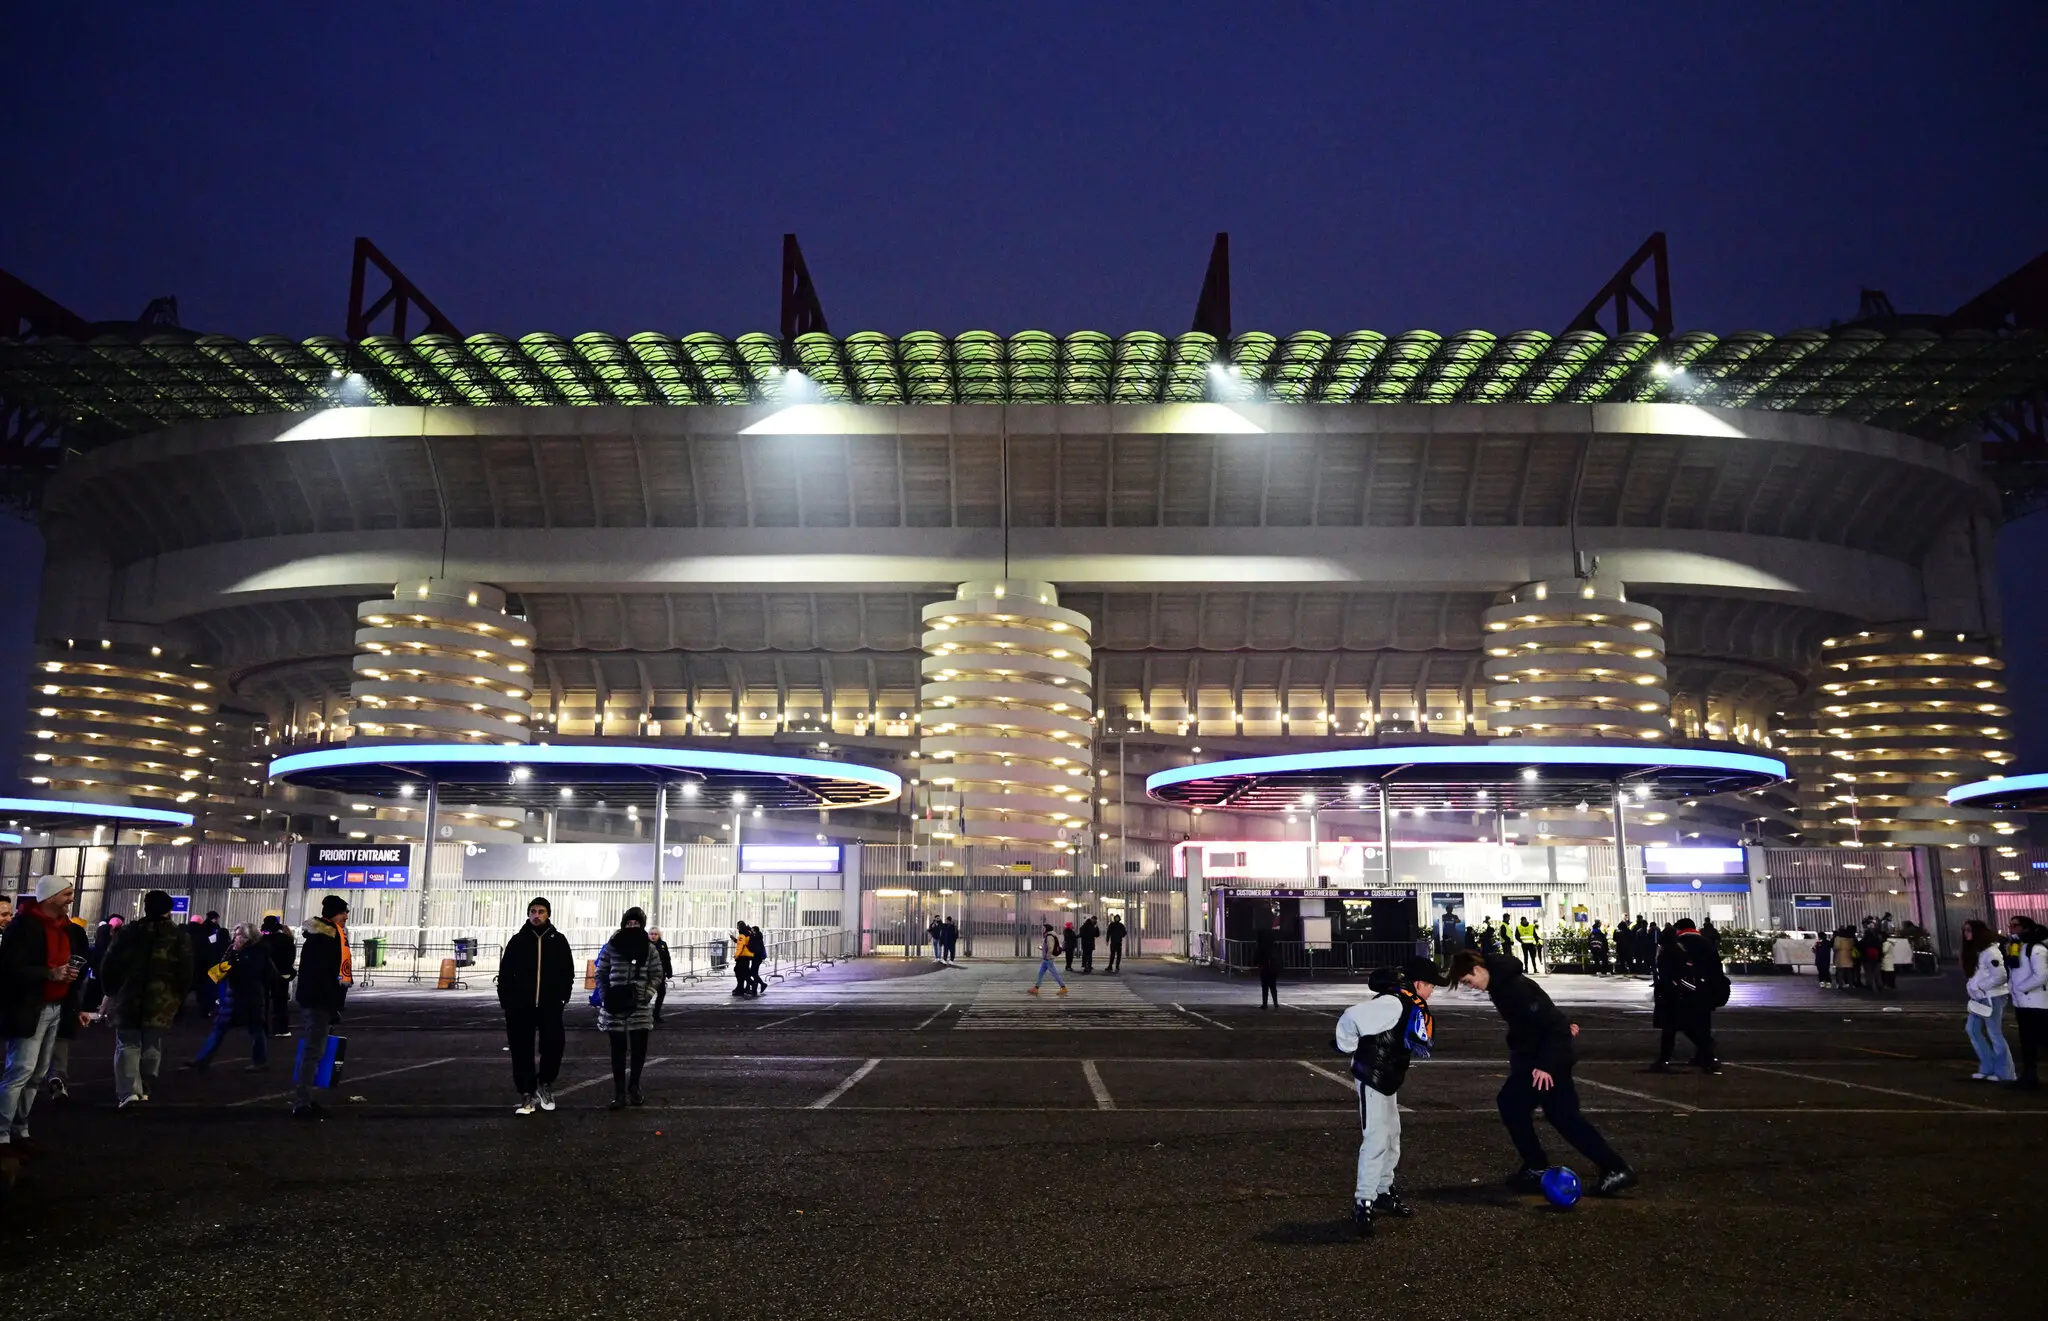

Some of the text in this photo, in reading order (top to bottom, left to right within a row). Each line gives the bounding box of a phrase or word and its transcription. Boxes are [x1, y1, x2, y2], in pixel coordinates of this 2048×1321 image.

[319, 849, 401, 862] PRIORITY ENTRANCE
[1500, 852, 1512, 876] 8
[1303, 889, 1339, 897] CUSTOMER BOX
[1371, 889, 1407, 897] CUSTOMER BOX
